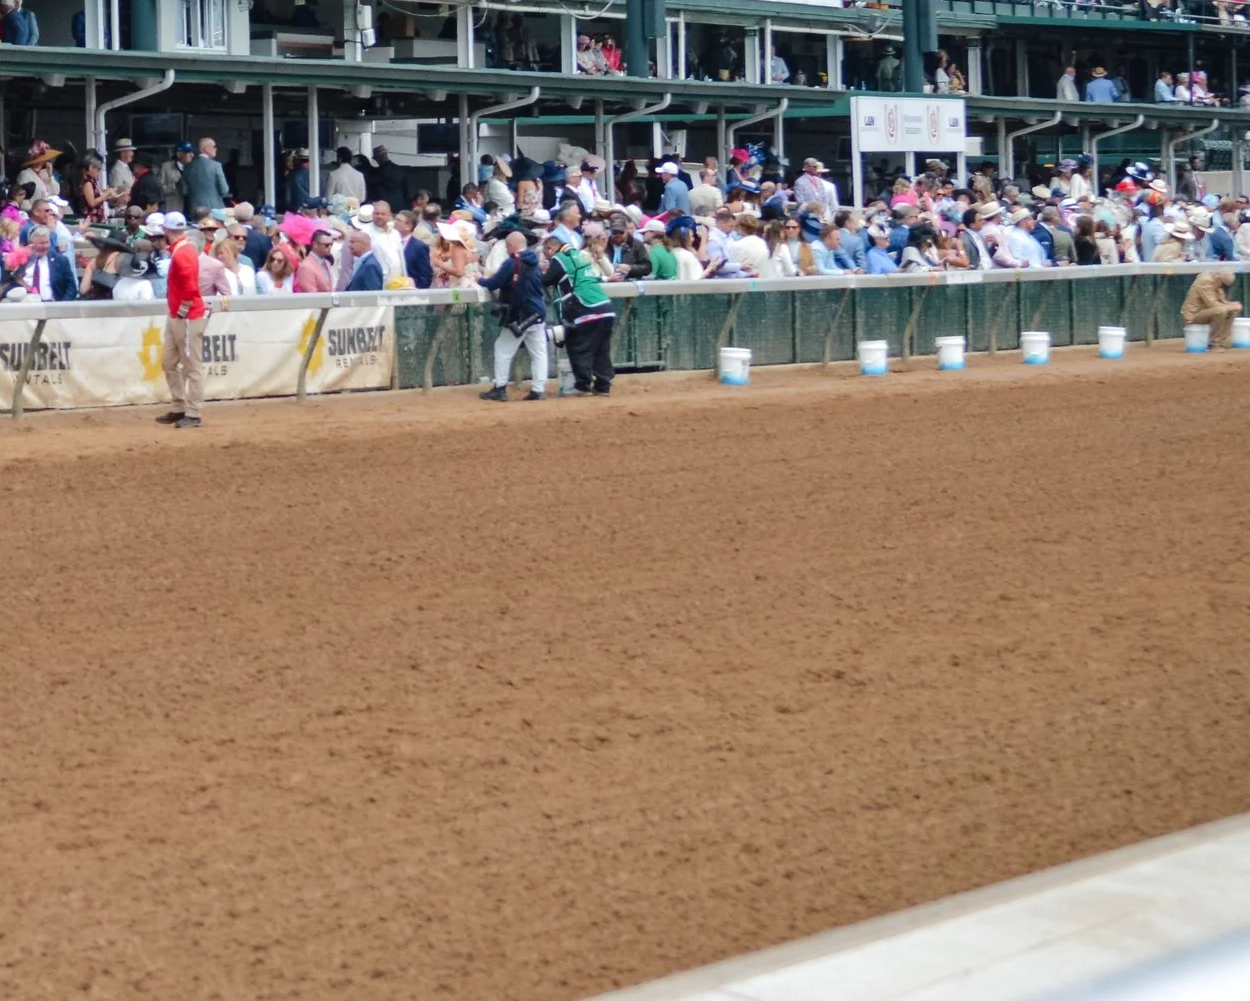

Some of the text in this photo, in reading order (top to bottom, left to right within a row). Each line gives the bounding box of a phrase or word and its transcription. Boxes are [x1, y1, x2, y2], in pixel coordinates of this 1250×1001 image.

[201, 334, 237, 363] BELT
[328, 325, 386, 356] SUNBELT
[335, 355, 377, 369] REALS
[13, 374, 63, 385] NTALS
